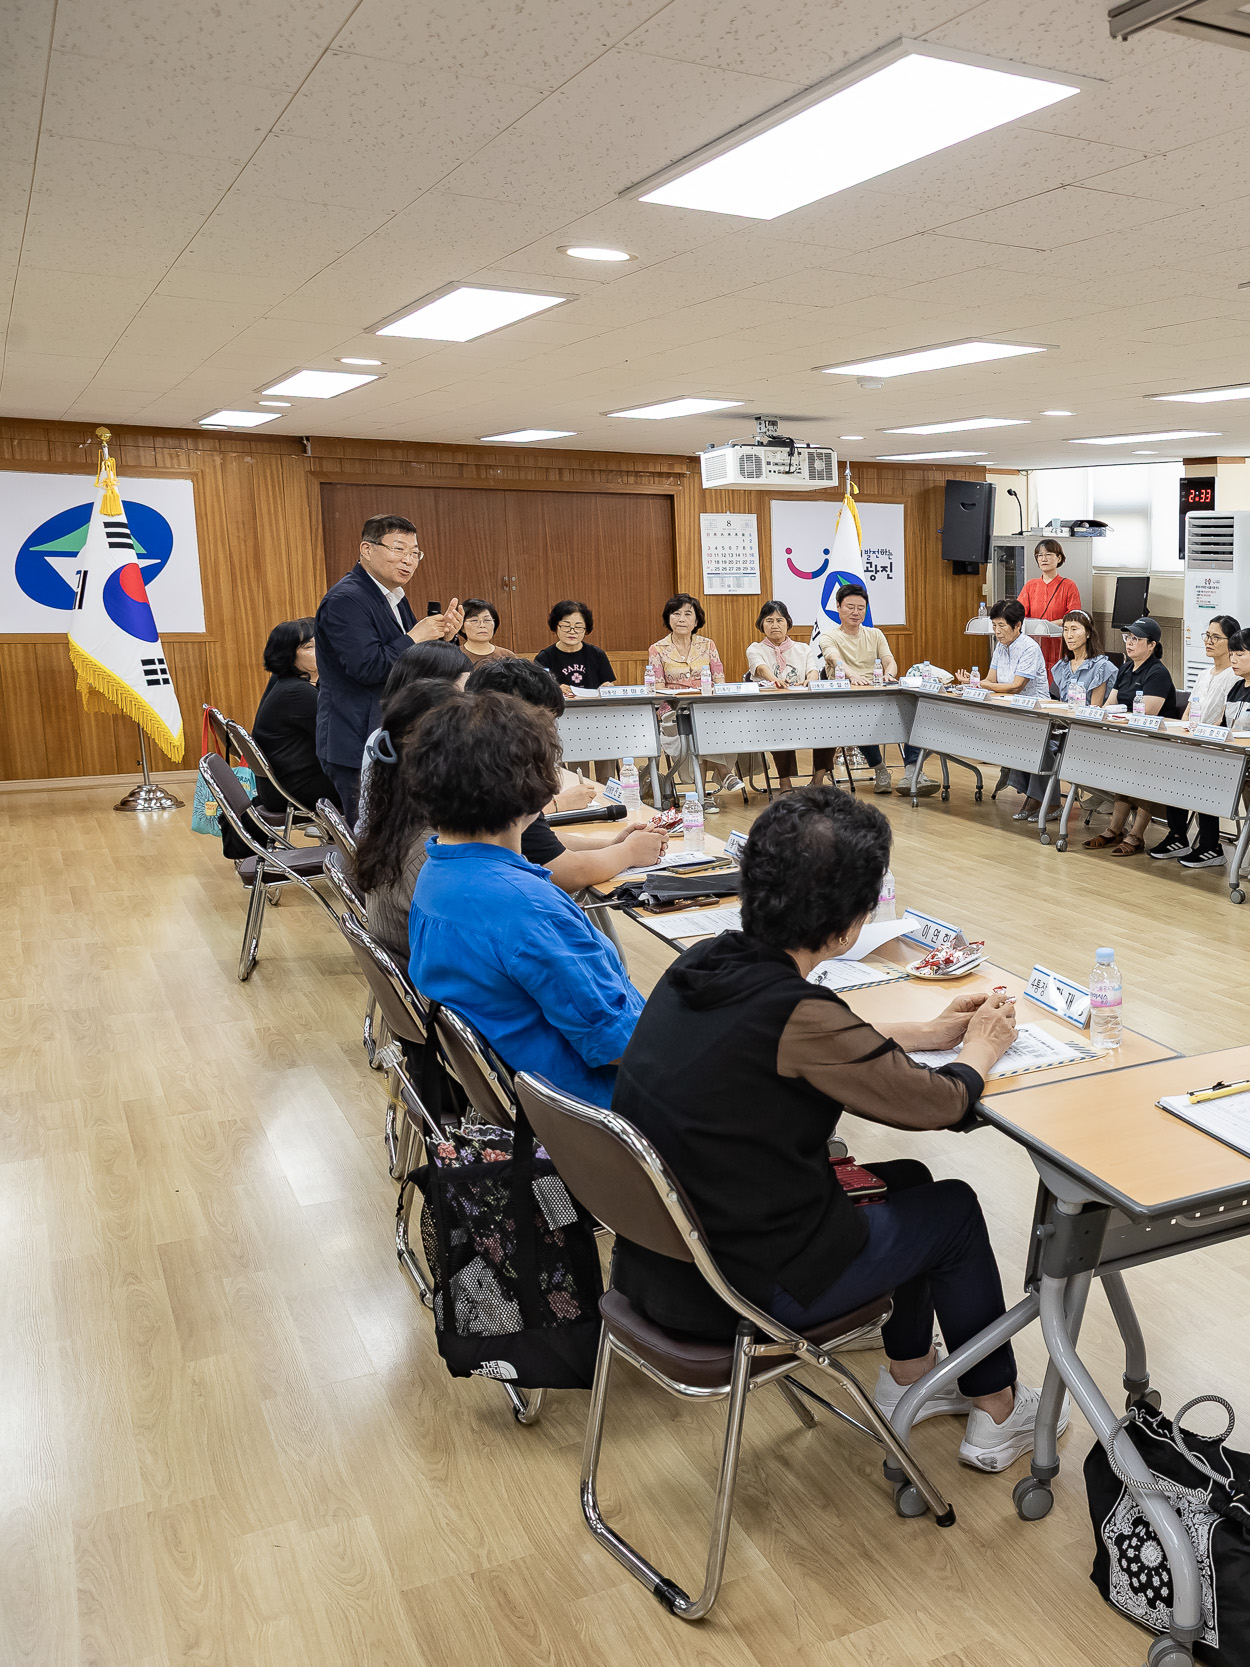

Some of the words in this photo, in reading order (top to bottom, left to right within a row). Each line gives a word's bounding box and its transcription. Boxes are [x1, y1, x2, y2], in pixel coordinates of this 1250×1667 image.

[1189, 489, 1211, 502] 2:33
[864, 549, 893, 560] 발전하는
[864, 561, 893, 581] 광진
[480, 1361, 498, 1369] THE
